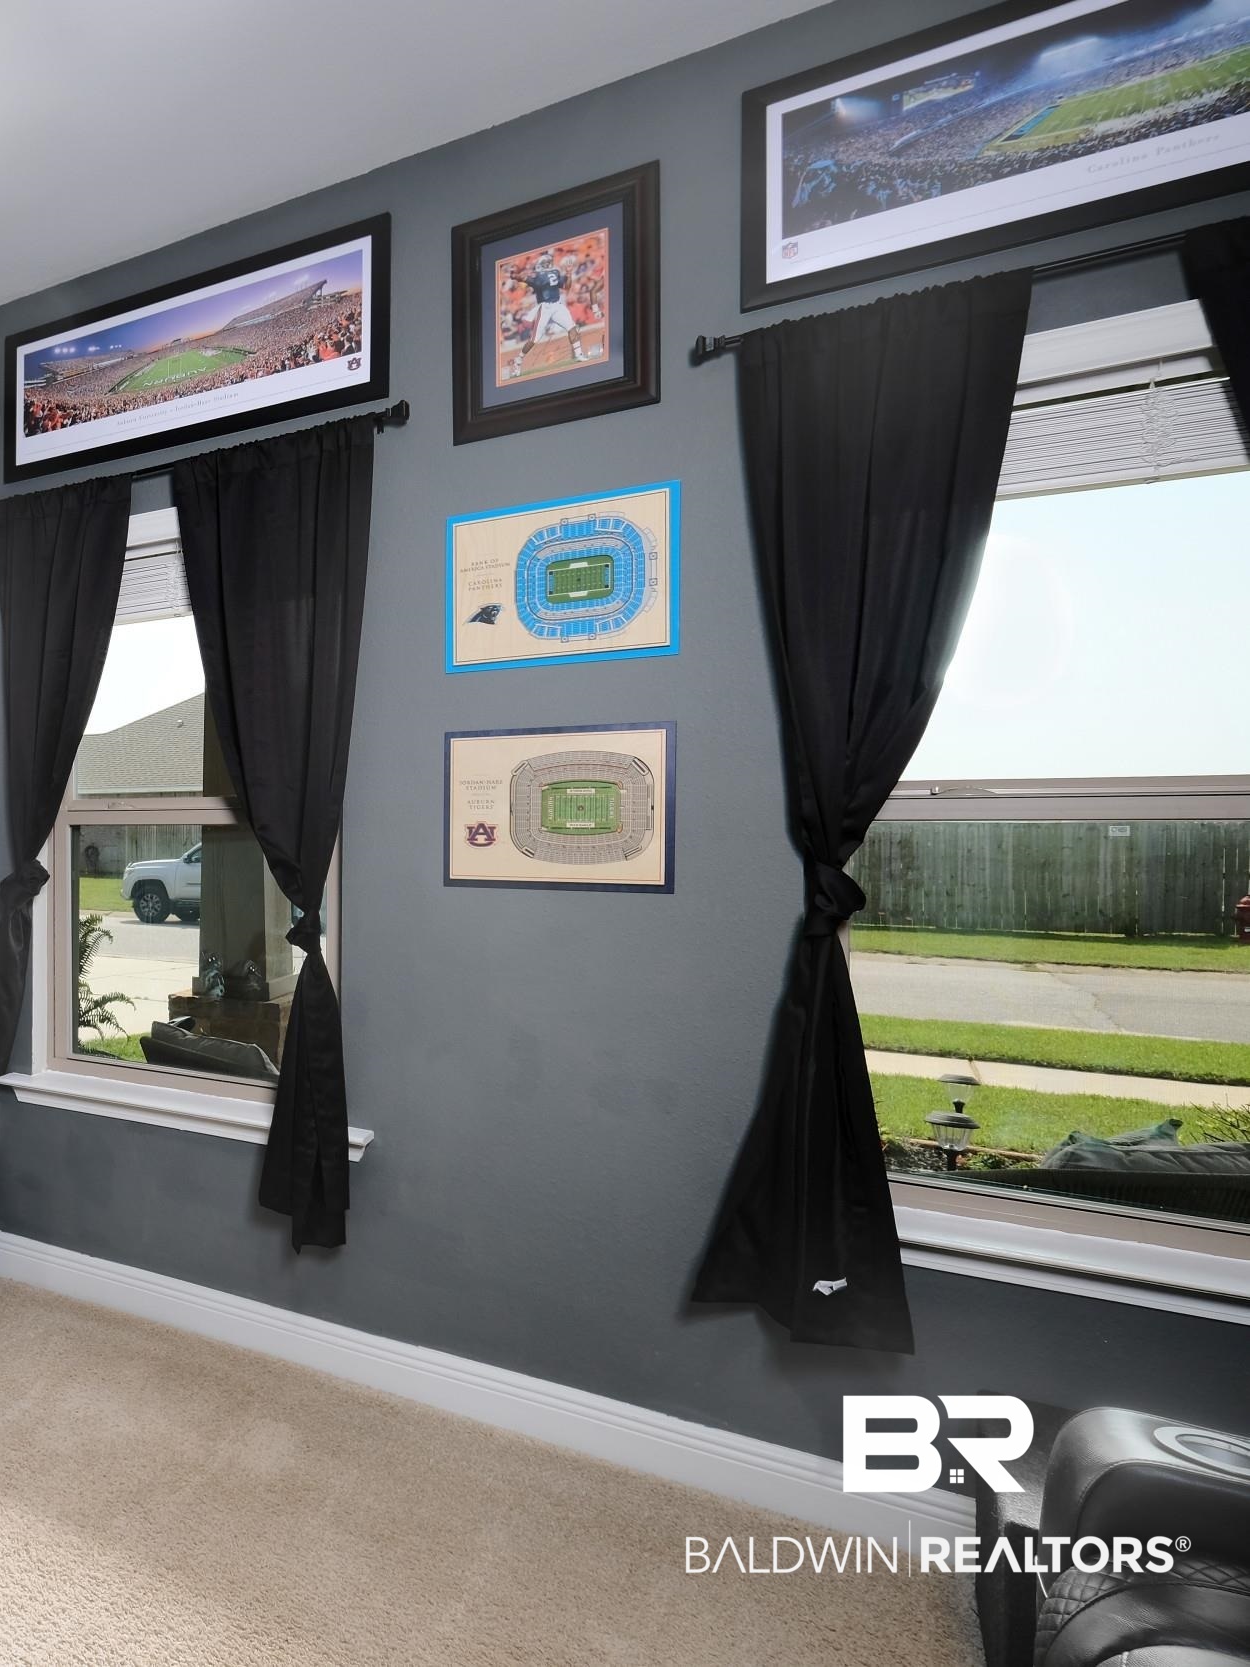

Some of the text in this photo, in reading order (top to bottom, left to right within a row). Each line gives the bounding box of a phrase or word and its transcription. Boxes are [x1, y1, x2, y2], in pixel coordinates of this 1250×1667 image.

[1088, 134, 1220, 173] Carolina Panthers
[548, 274, 559, 286] 2
